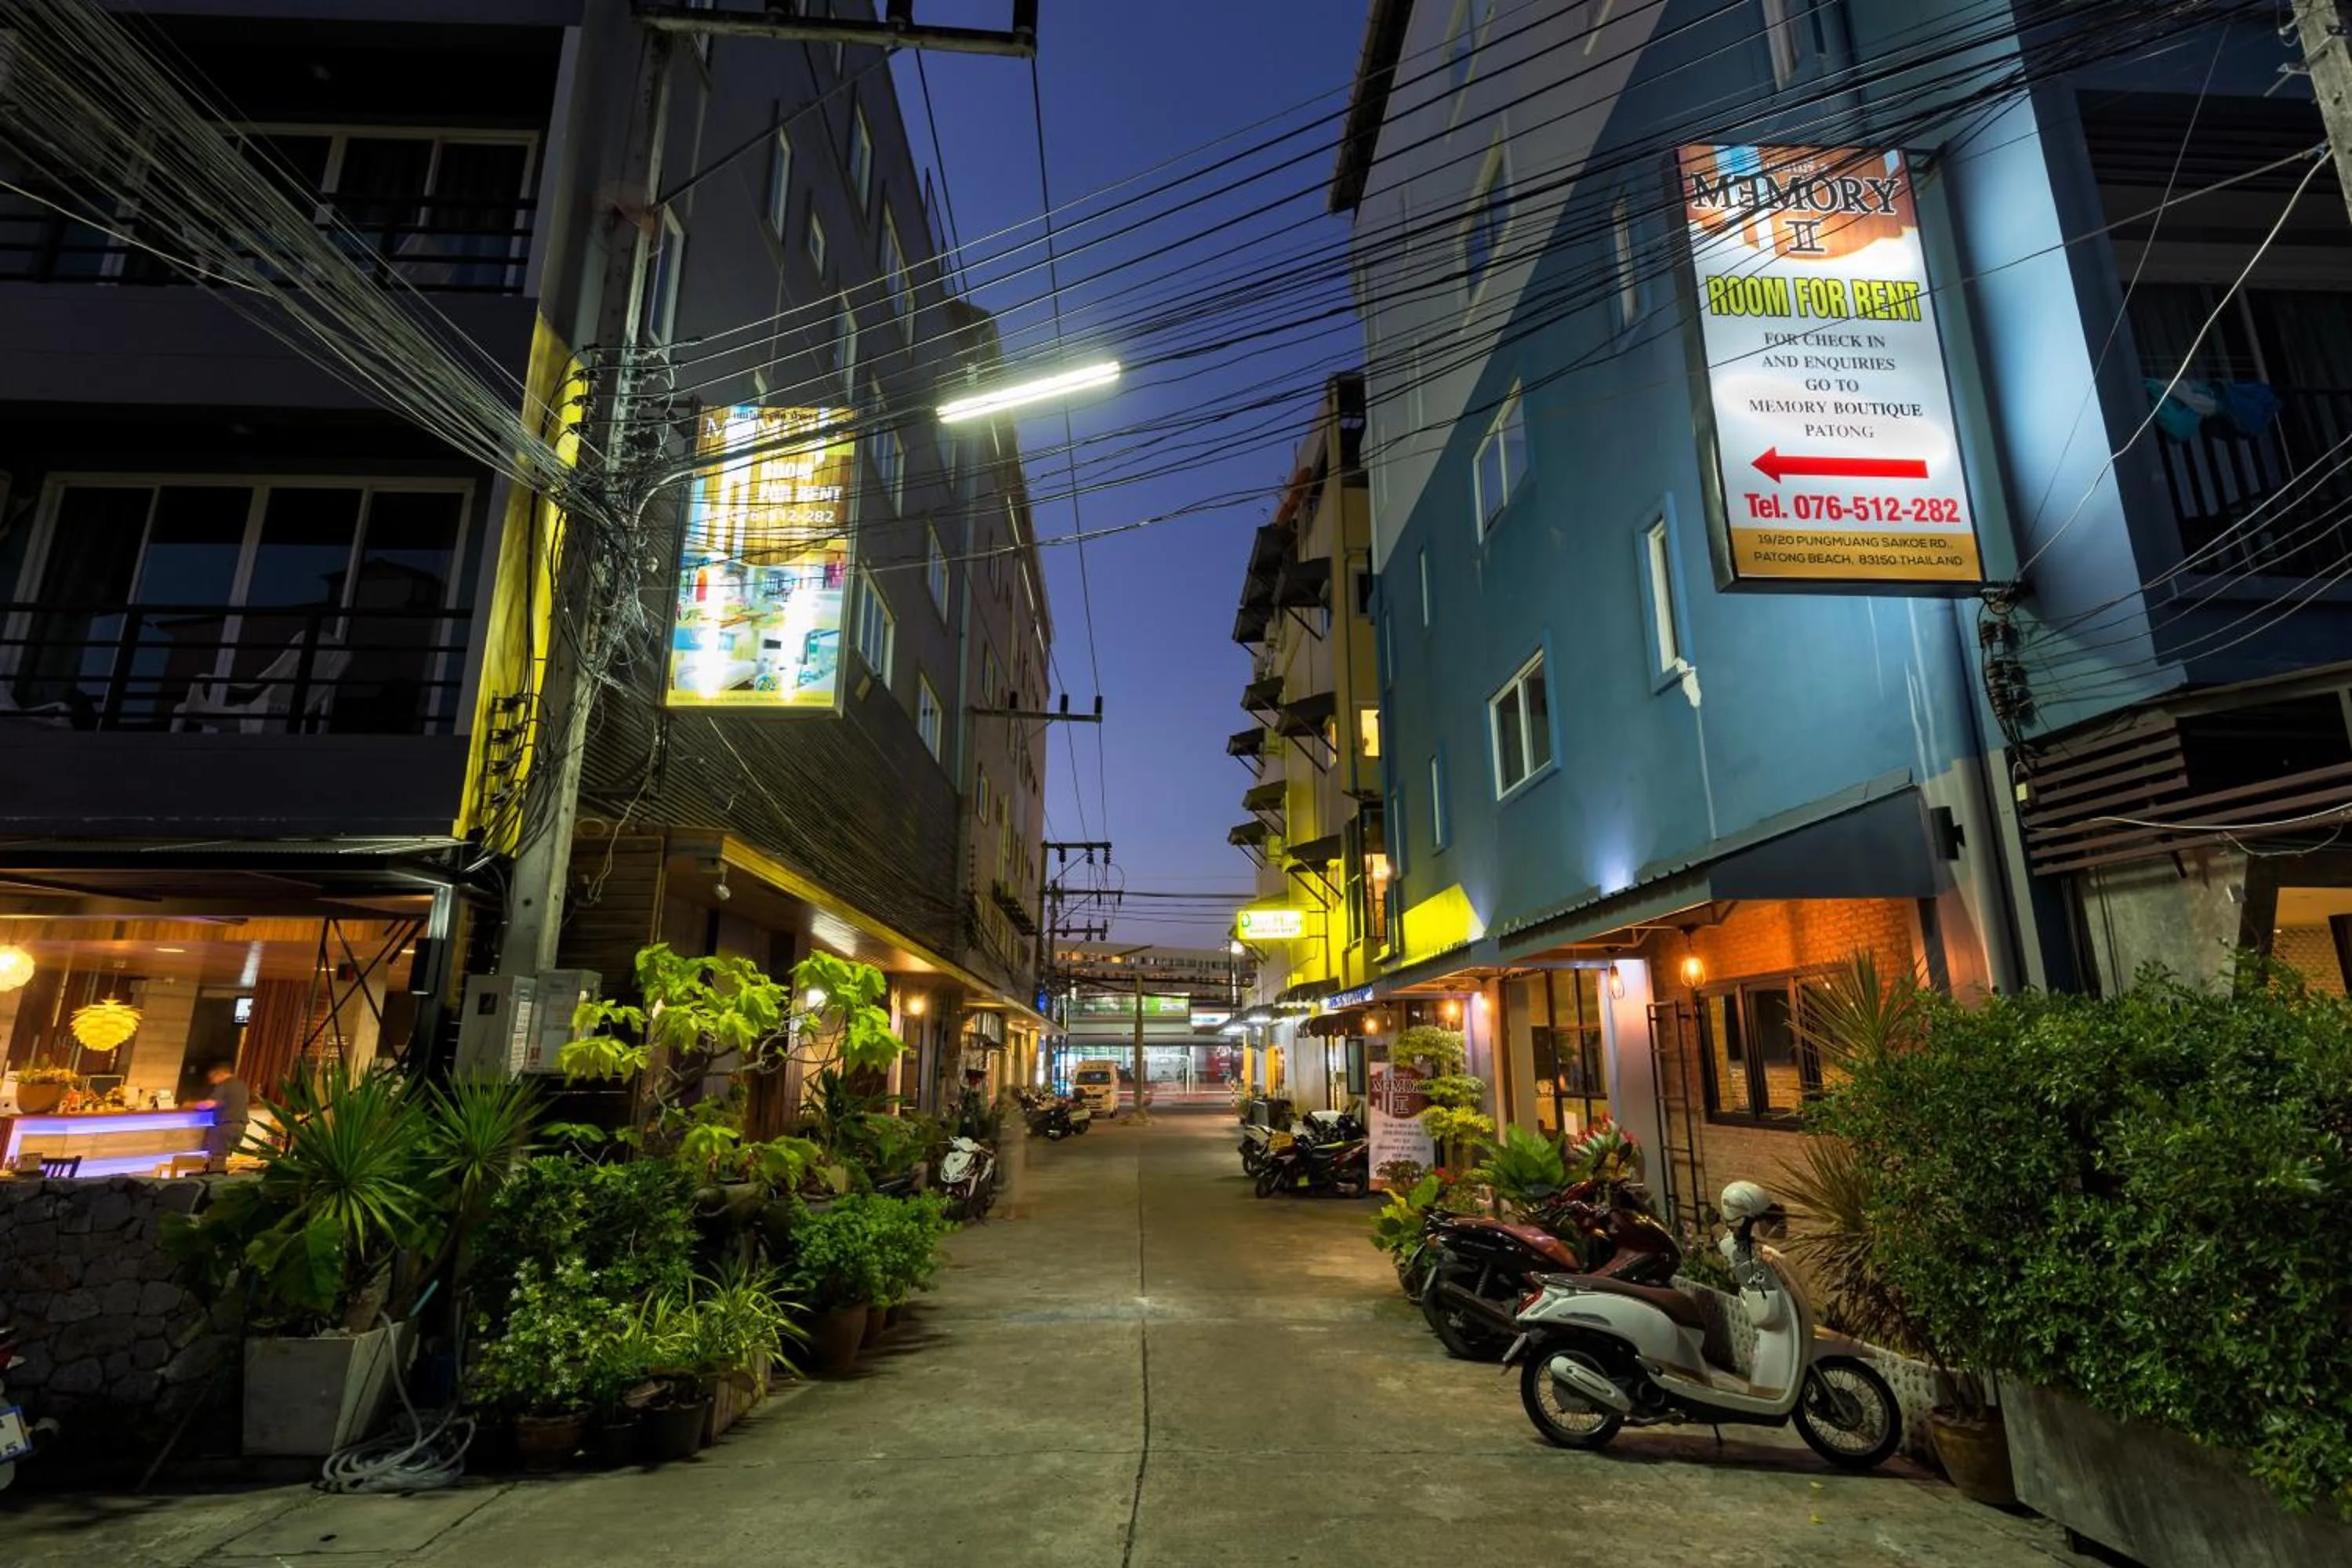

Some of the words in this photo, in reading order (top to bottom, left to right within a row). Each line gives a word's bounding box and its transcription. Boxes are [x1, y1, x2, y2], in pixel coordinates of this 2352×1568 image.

[1692, 172, 1900, 215] MEMORY
[1707, 275, 1790, 317] ROOM
[1793, 278, 1849, 319] FOR
[1851, 278, 1922, 321] RENT
[1764, 332, 1798, 346] FOR
[1804, 334, 1862, 347] CHECK
[1868, 335, 1886, 347] IN
[1762, 355, 1798, 368] AND
[1804, 356, 1896, 371] ENQUIRIES
[1805, 379, 1831, 391] GO
[1835, 379, 1860, 392] TO
[1749, 399, 1827, 413] MEMORY
[1834, 401, 1923, 418] BOUTIQUE
[1805, 424, 1874, 438] PATONG
[1744, 492, 1788, 518] Tel.
[1793, 494, 1962, 523] 076-512-282
[1758, 533, 1795, 546] 19/20
[1797, 535, 1879, 548] PUNGMUANG
[1754, 551, 1805, 563] PATONG
[1858, 554, 1897, 565] 83150
[1900, 555, 1963, 566] THAILAND
